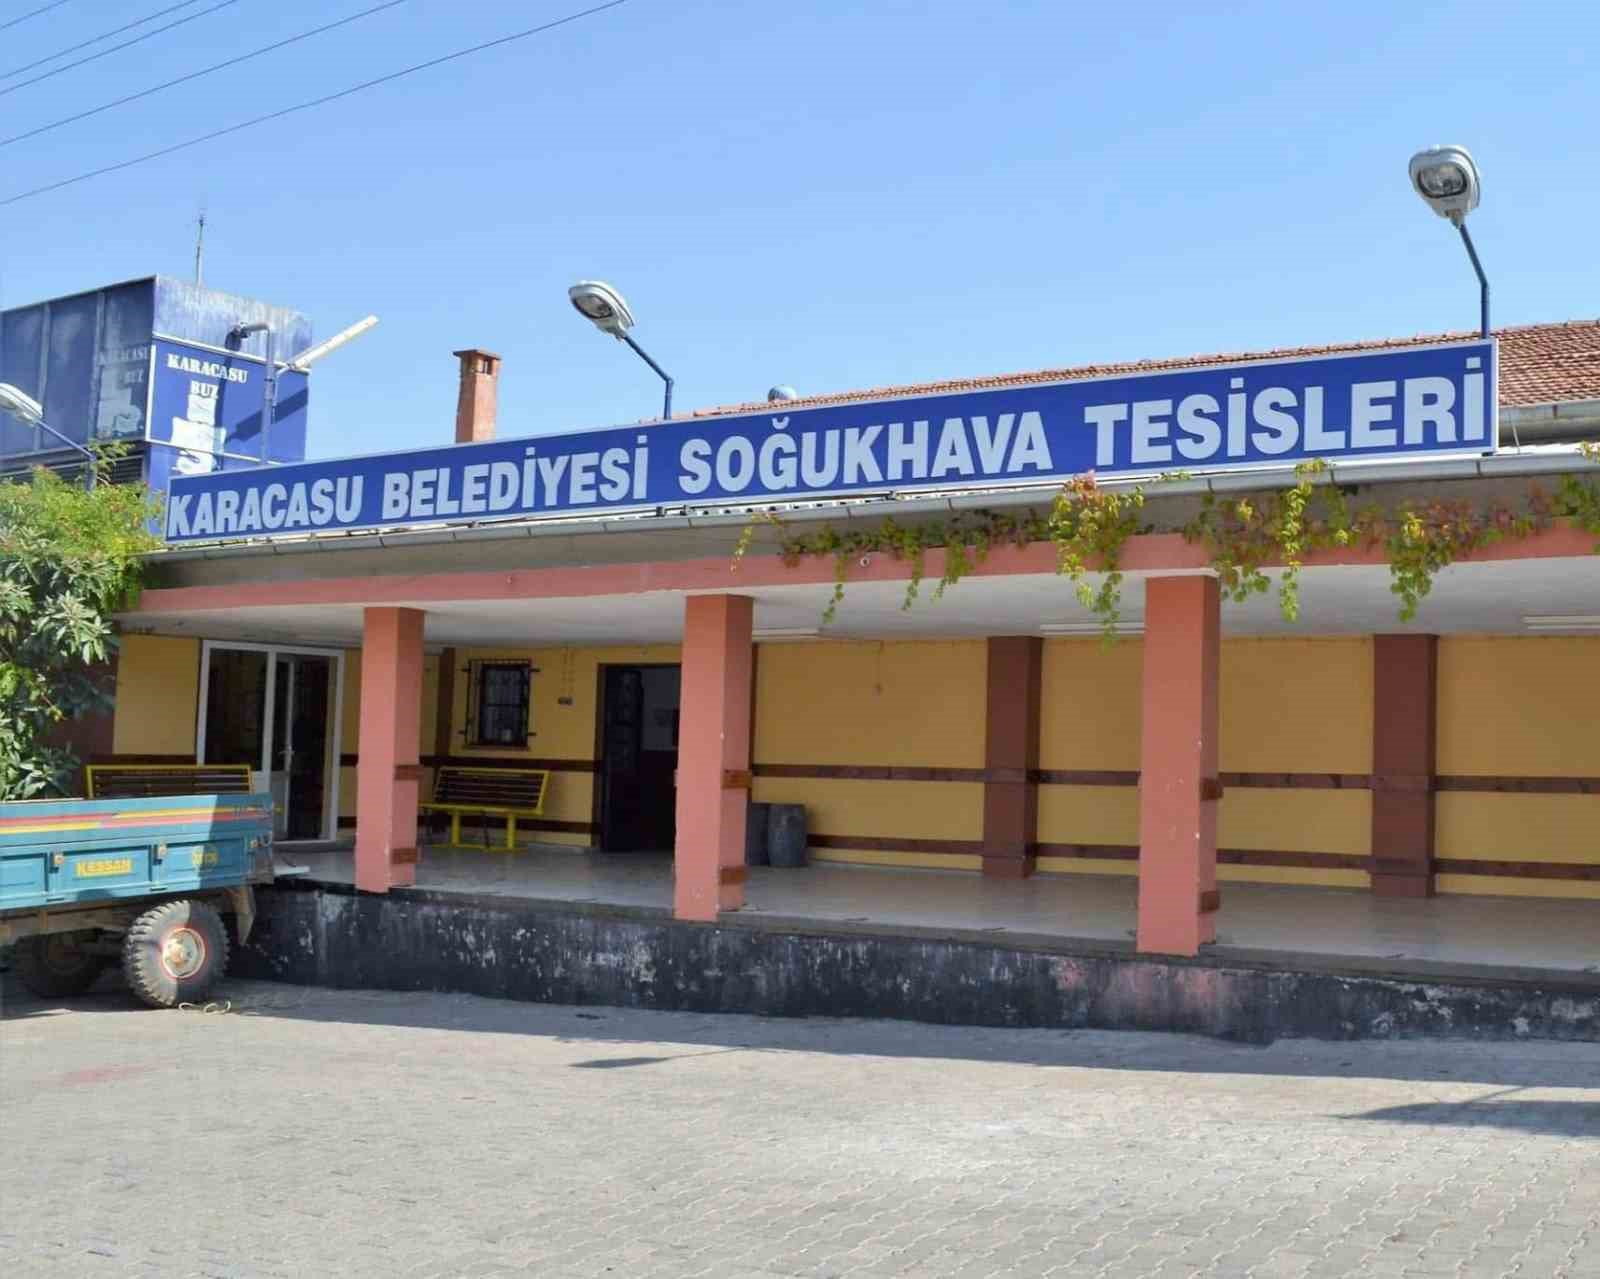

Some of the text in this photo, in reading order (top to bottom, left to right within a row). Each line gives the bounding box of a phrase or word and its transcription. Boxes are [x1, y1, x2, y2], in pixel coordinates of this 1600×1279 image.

[167, 352, 249, 384] KARACASU
[190, 380, 219, 398] BUZ
[168, 356, 1485, 538] KARACASU BELEDİYESİ SOĞUKHAVA TESİSLERİ
